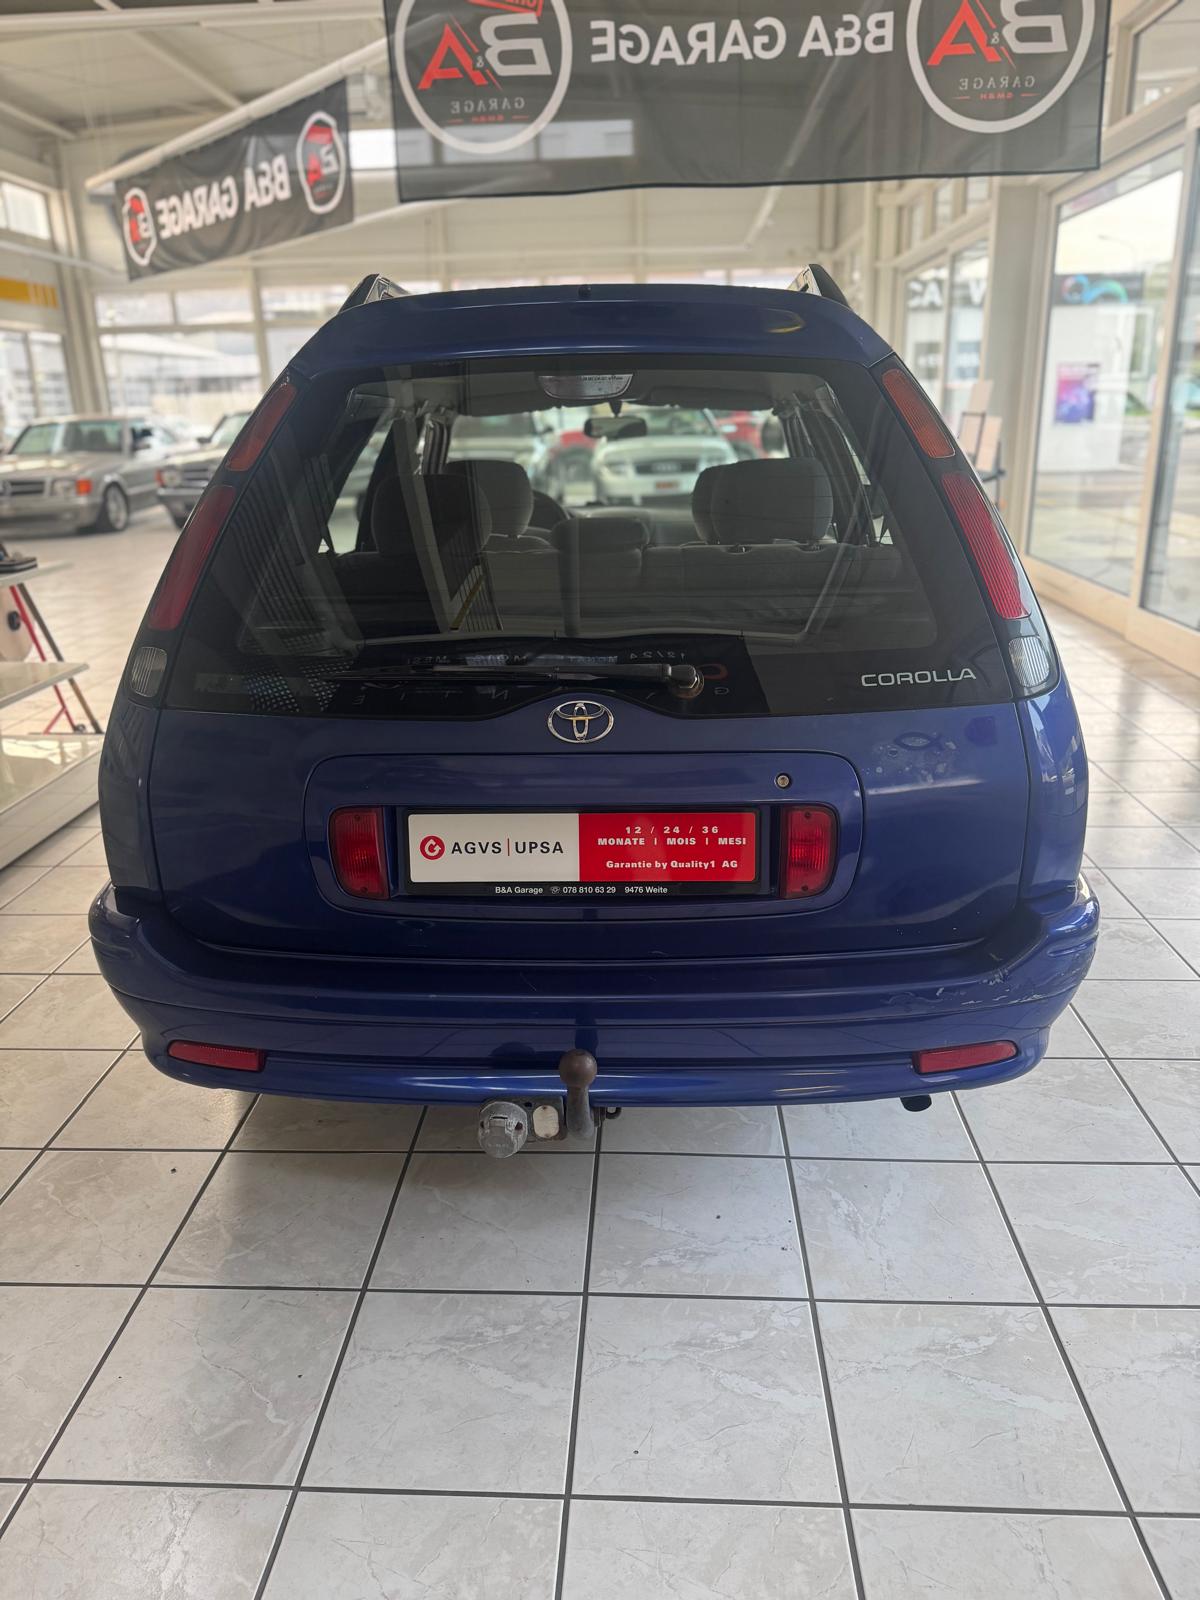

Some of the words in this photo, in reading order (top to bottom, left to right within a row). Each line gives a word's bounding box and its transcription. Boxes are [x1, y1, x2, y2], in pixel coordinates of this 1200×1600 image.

[861, 668, 976, 687] COROLLA
[597, 837, 645, 846] MONATE
[666, 837, 697, 845] MOIS
[718, 837, 747, 845] MESI
[451, 841, 502, 854] AGVS
[515, 841, 564, 854] UPSA
[606, 860, 652, 868] Garantie
[654, 860, 667, 869] by
[670, 860, 716, 870] Quality1
[722, 860, 738, 868] AG
[495, 886, 513, 894] B&A
[514, 886, 544, 895] Garage
[562, 886, 577, 894] 078
[579, 886, 594, 894] 810
[595, 886, 605, 894] 63
[606, 886, 616, 894] 29
[624, 886, 643, 894] 9476
[645, 886, 668, 894] Weite
